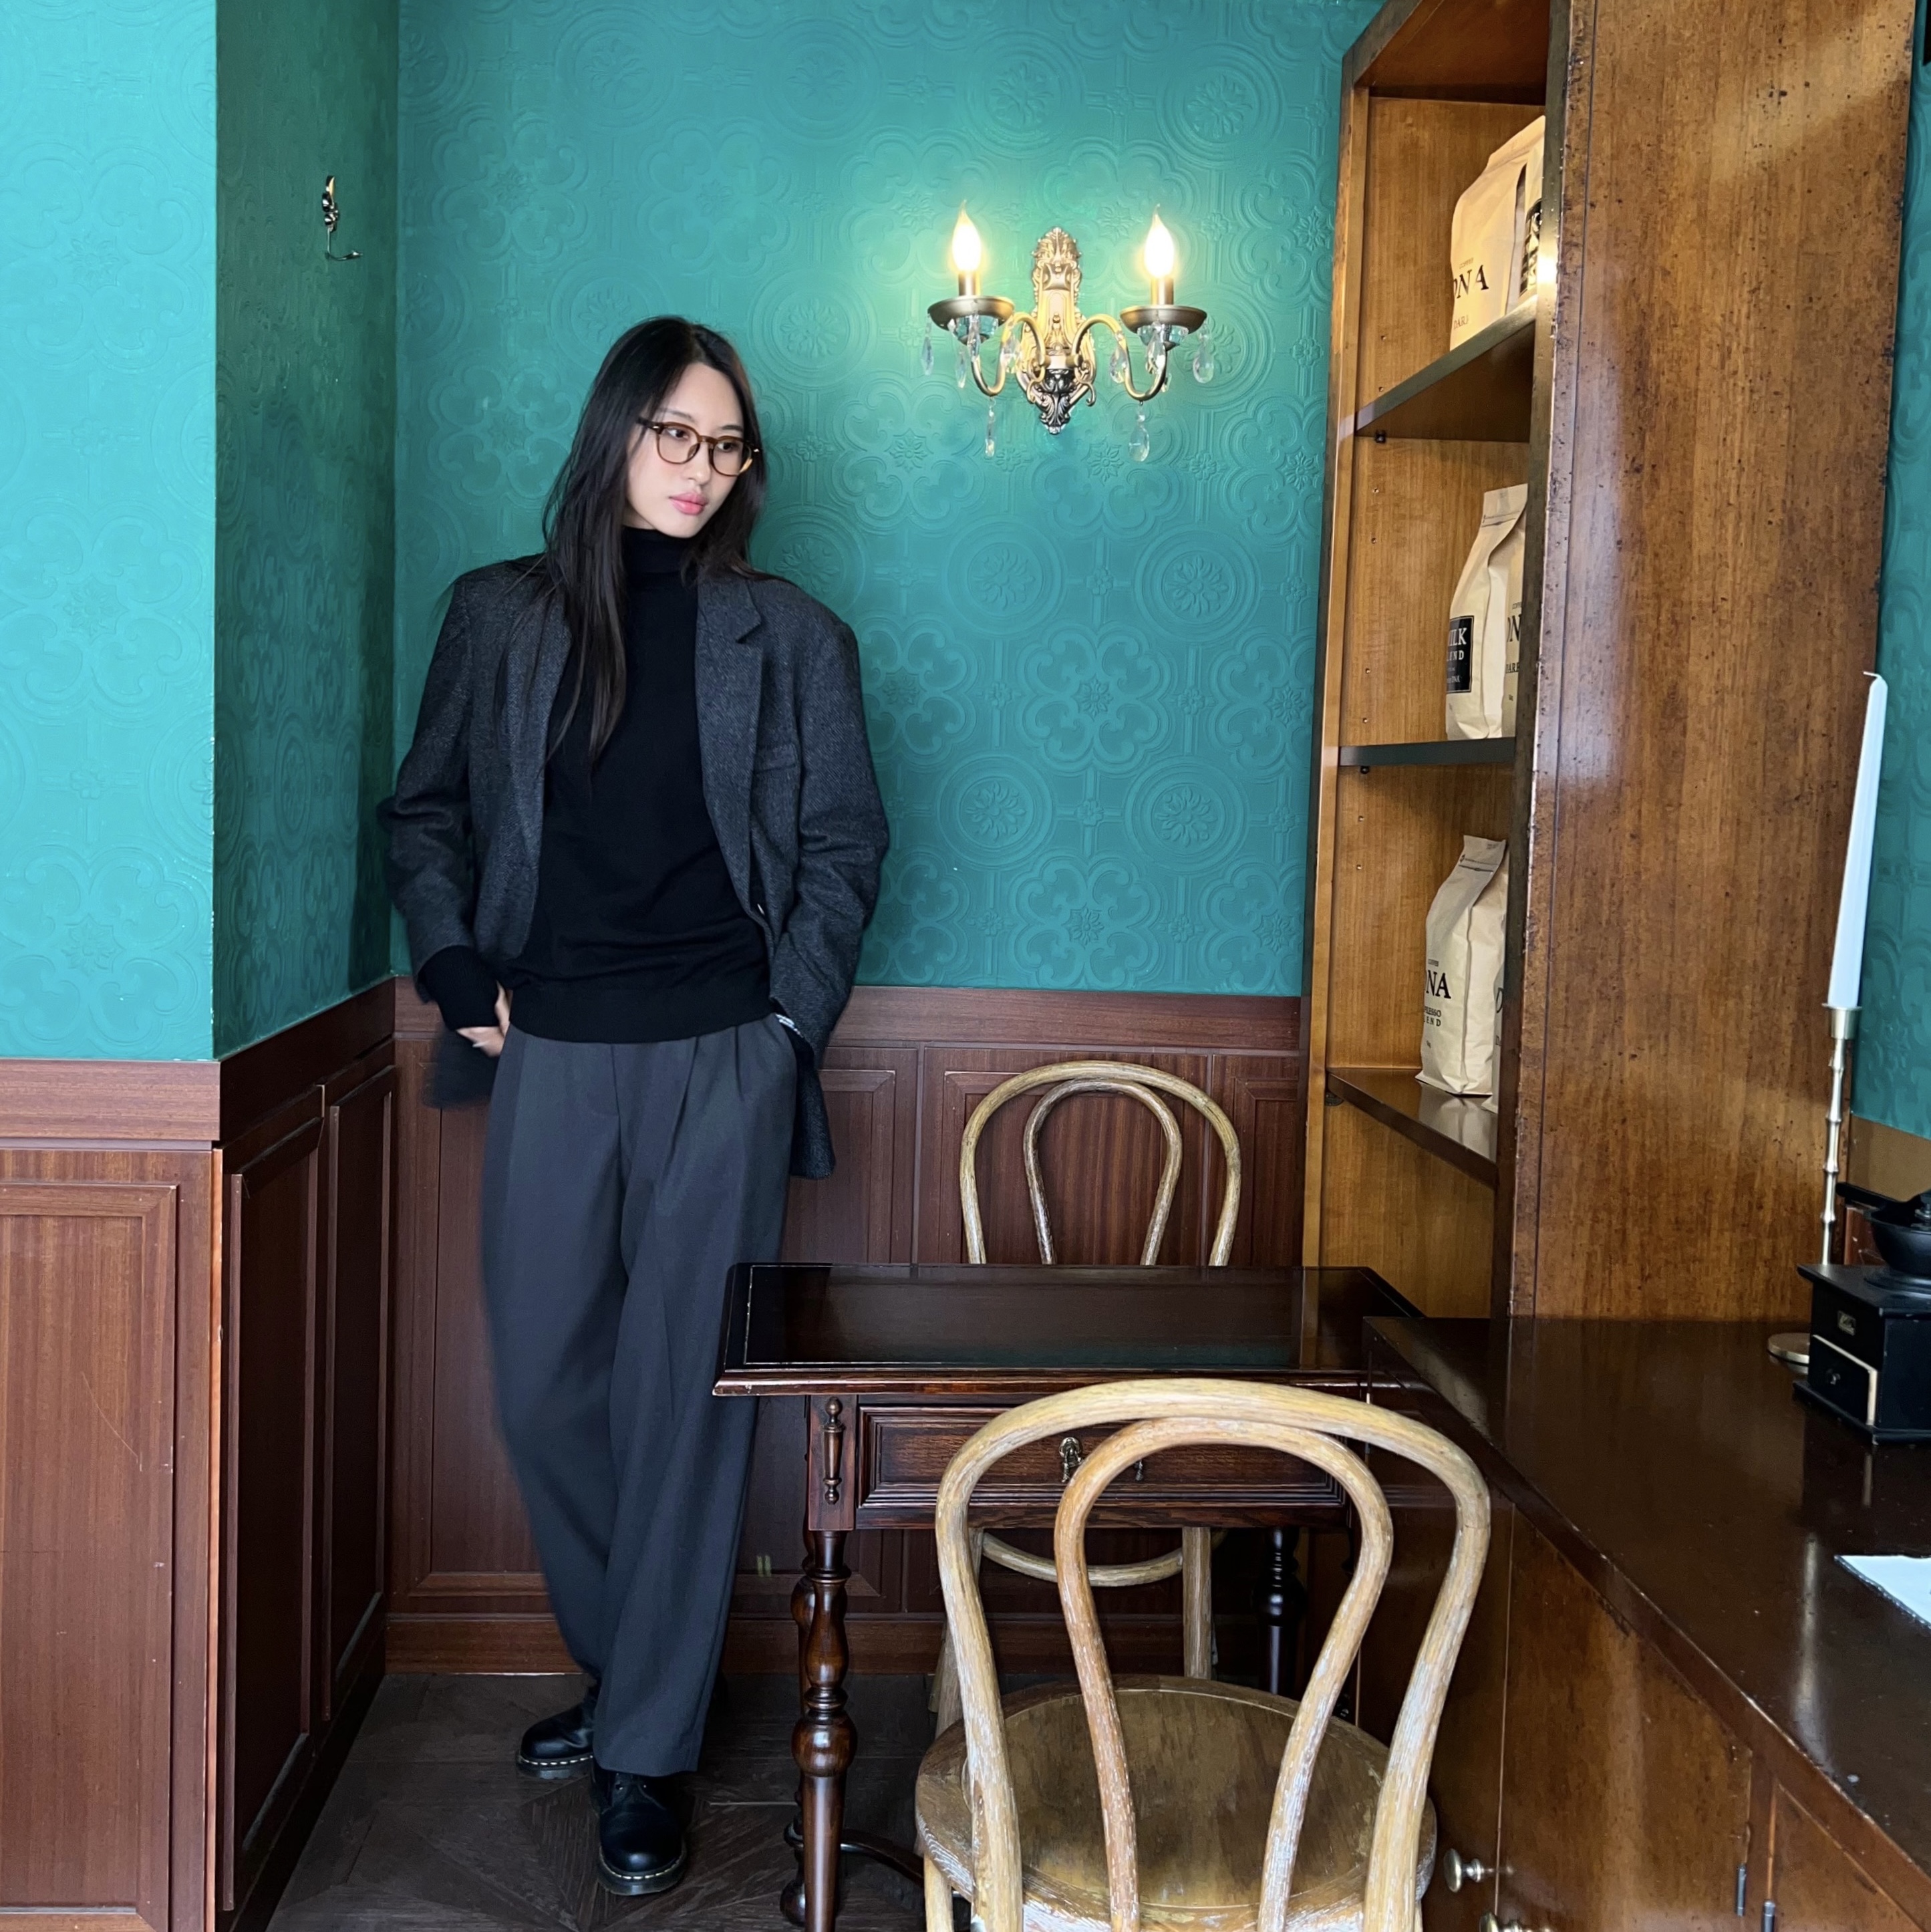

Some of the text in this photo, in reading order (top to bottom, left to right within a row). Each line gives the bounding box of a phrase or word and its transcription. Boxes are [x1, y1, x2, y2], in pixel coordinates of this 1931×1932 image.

[1449, 628, 1467, 646] ILK
[1447, 650, 1465, 662] END
[1426, 970, 1451, 999] NA
[1424, 1016, 1441, 1027] END
